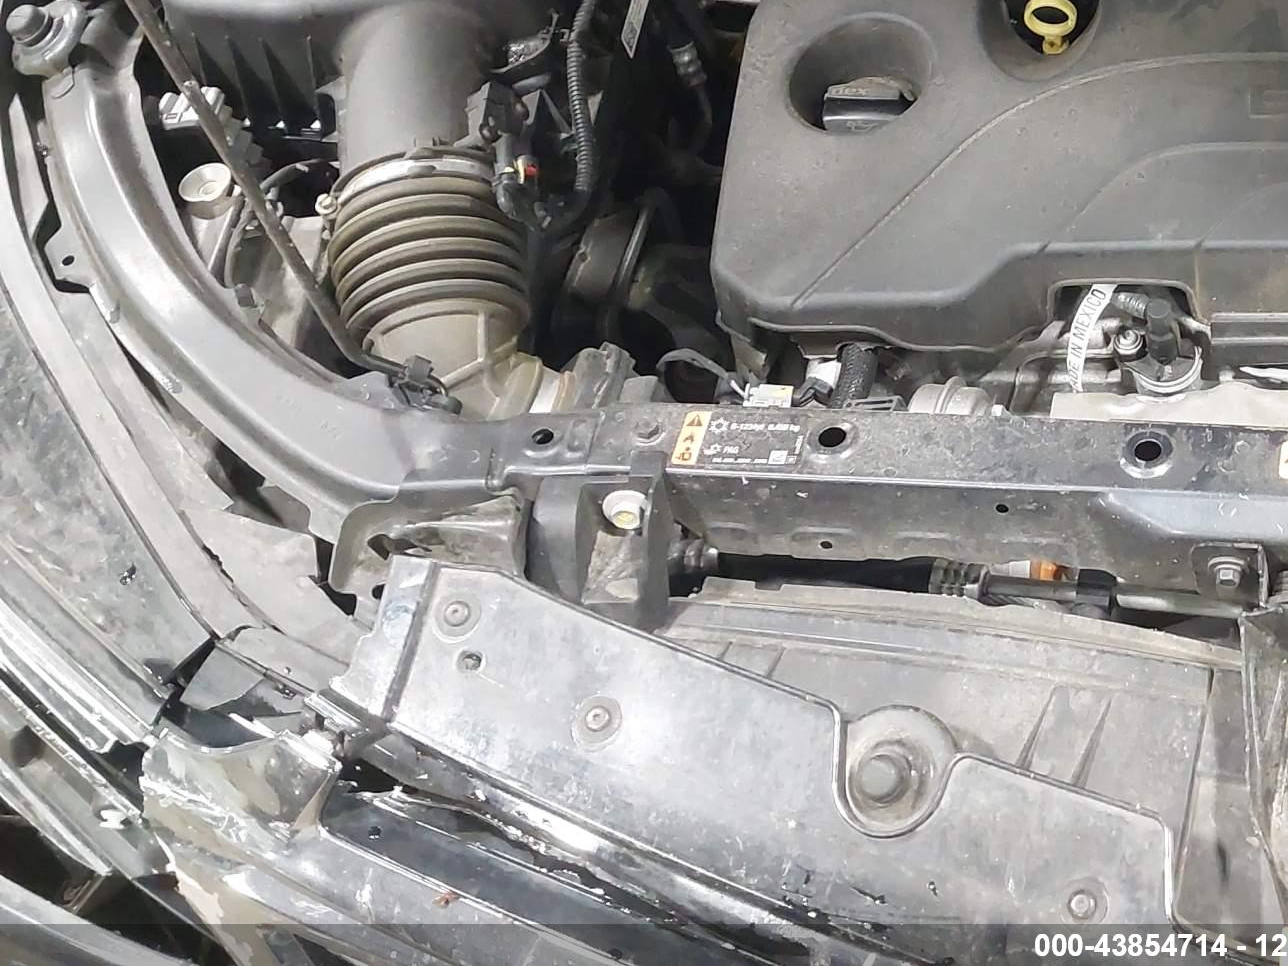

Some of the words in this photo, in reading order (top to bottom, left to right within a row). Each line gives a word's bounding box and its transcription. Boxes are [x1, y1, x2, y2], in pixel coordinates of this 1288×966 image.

[1072, 288, 1107, 341] MEXICO
[1070, 342, 1084, 359] IN
[1068, 359, 1082, 390] ADE
